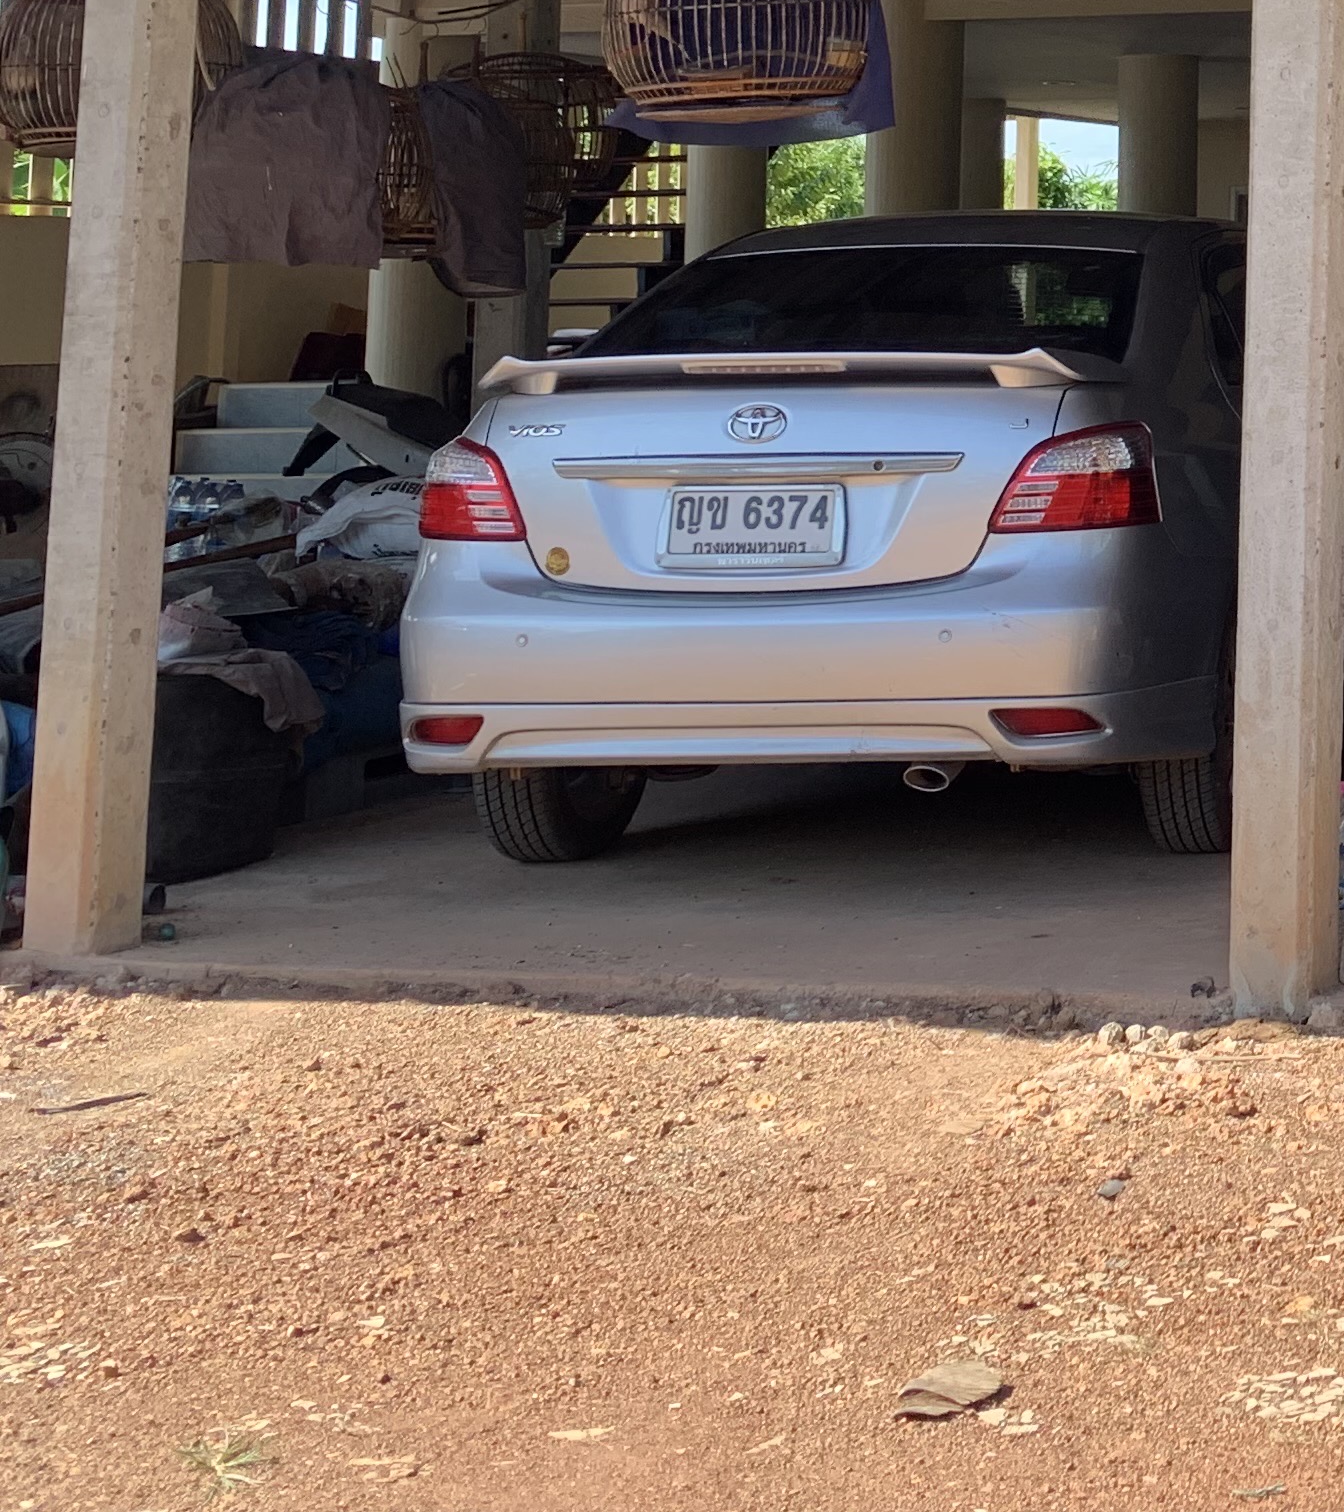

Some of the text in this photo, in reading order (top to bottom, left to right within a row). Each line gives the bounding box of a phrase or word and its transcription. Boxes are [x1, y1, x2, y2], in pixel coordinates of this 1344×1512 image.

[508, 424, 566, 437] VIOS
[676, 495, 829, 534] ญข 6374
[693, 541, 807, 554] กรงเทพมหานคร
